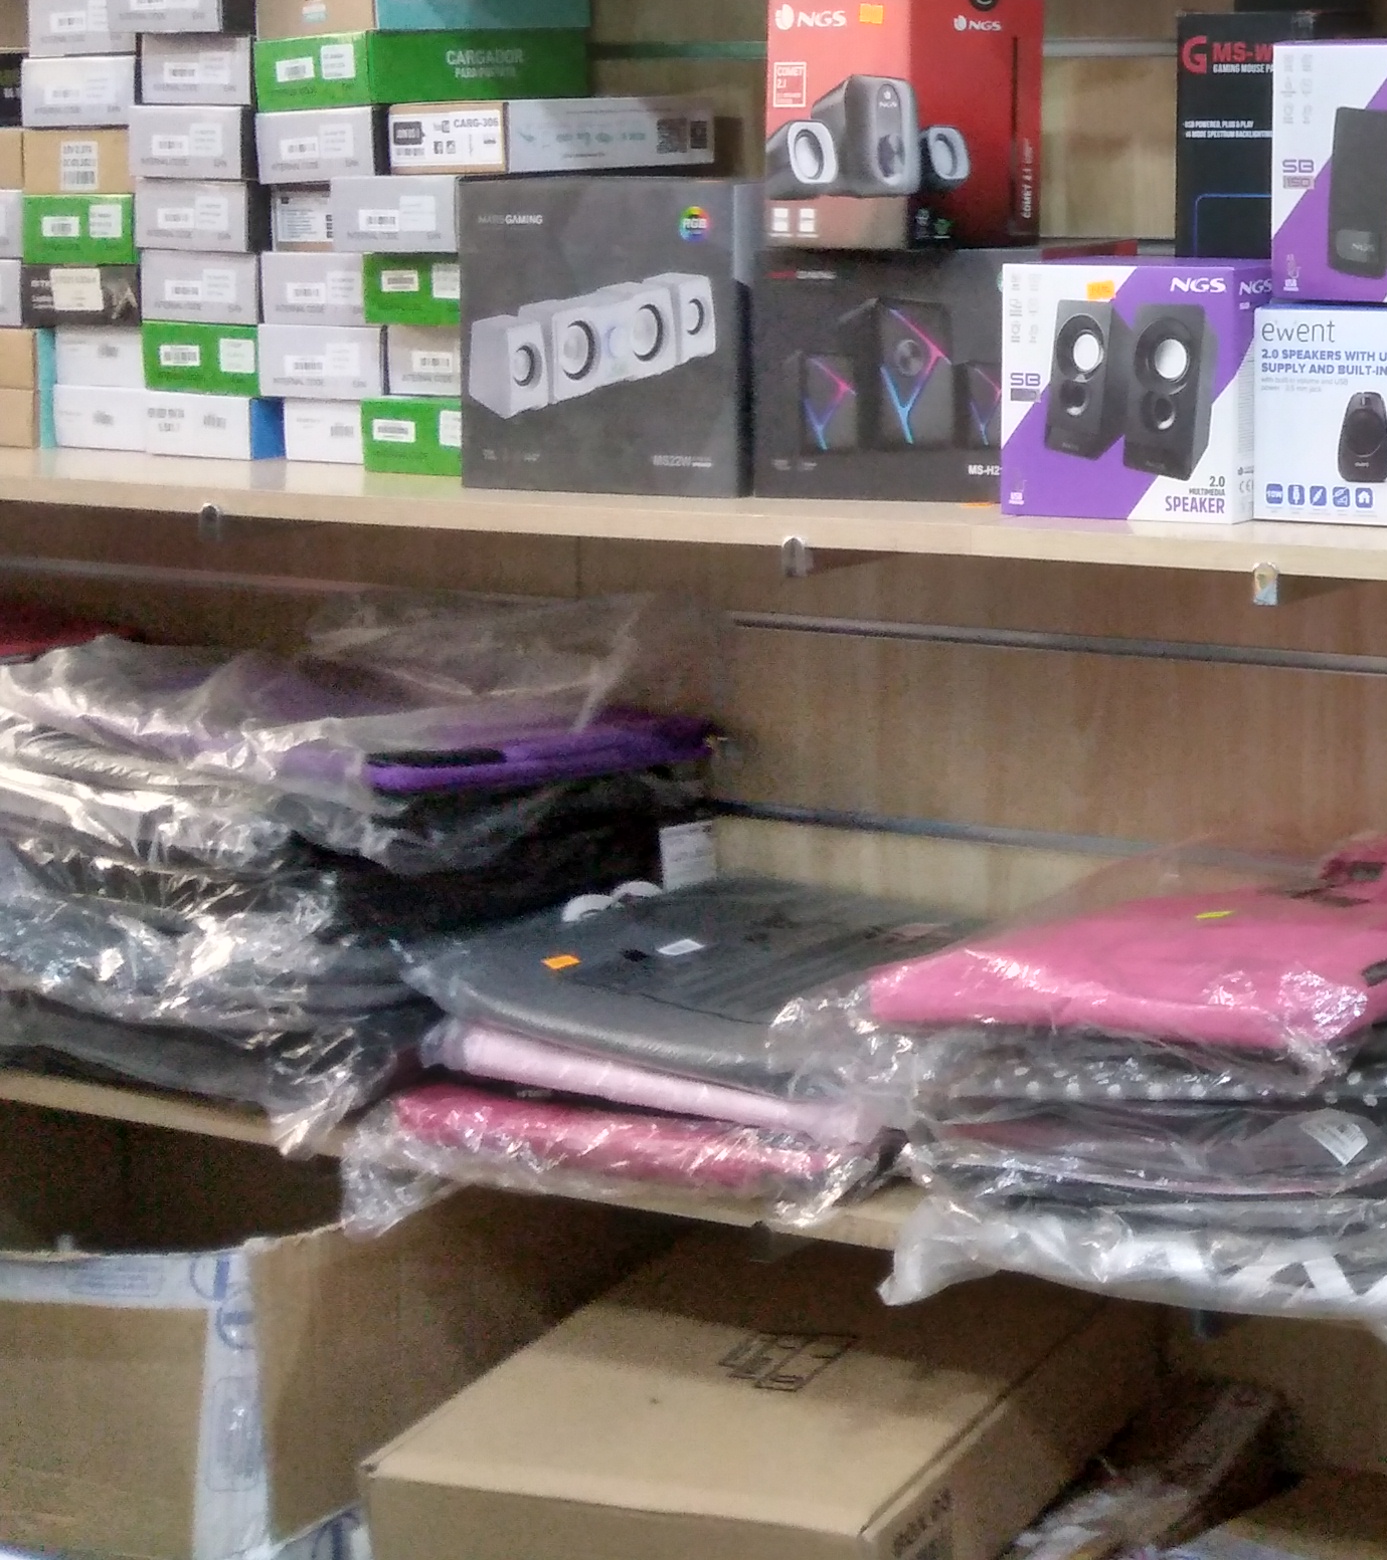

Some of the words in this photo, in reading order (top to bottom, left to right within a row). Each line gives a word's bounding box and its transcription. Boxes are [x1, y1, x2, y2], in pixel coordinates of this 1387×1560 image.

[797, 10, 848, 28] NGS
[966, 19, 1002, 32] NGS
[445, 48, 524, 66] CARGADOR
[1282, 158, 1315, 174] SB
[505, 213, 543, 225] GAMING
[1169, 276, 1227, 295] NGS
[1261, 320, 1336, 344] ewent
[1261, 349, 1279, 360] 2.0
[1282, 349, 1342, 361] SPEAKERS
[1344, 351, 1376, 362] WITH
[1261, 361, 1306, 374] SUPPLY
[1308, 363, 1335, 375] AND
[1009, 372, 1042, 387] SB
[1209, 475, 1226, 488] 2.0
[1188, 487, 1226, 498] MULTIMEDIA
[1164, 496, 1226, 515] SPEAKER
